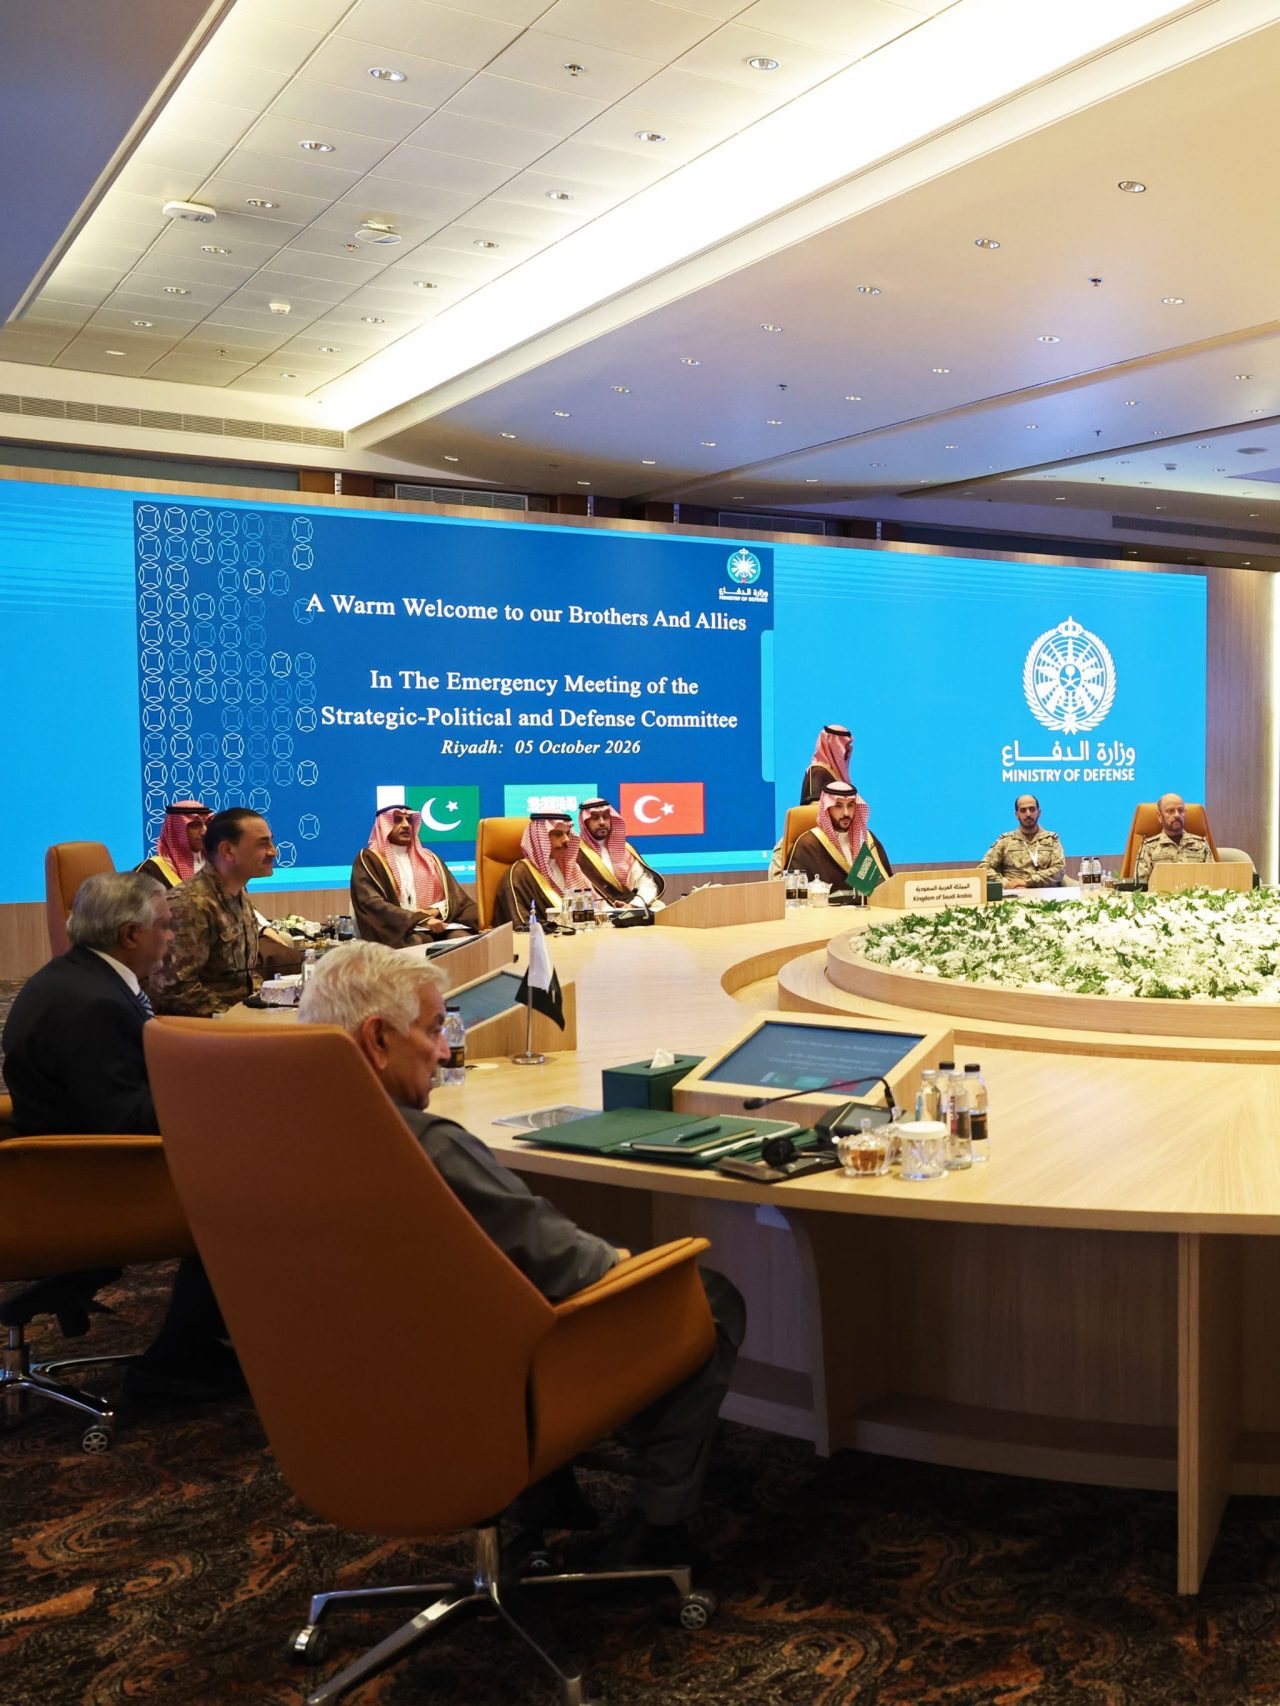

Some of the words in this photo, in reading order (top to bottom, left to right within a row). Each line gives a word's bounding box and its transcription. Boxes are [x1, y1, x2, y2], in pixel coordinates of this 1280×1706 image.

[306, 593, 325, 612] A
[330, 594, 396, 615] Warm
[402, 598, 498, 619] Welcome
[504, 604, 524, 621] to
[530, 608, 563, 623] our
[568, 606, 649, 626] Brothers
[653, 610, 691, 628] And
[695, 612, 747, 631] Allies
[370, 670, 392, 689] In
[399, 671, 440, 690] The
[446, 672, 558, 696] Emergency
[564, 675, 641, 698] Meeting
[647, 677, 668, 694] of
[671, 677, 699, 695] the
[321, 706, 512, 730] Strategic-Political
[519, 709, 554, 727] and
[559, 709, 636, 727] Defense
[641, 710, 738, 728] Committee
[441, 739, 504, 757] Riyadh:
[515, 740, 533, 754] 05
[539, 739, 601, 754] October
[604, 739, 641, 754] 2026
[1001, 740, 1090, 767] الدفاع
[1097, 740, 1136, 766] وزارة
[1002, 769, 1062, 782] MINISTRY
[1064, 769, 1080, 781] OF
[1083, 768, 1135, 781] DEFENSE
